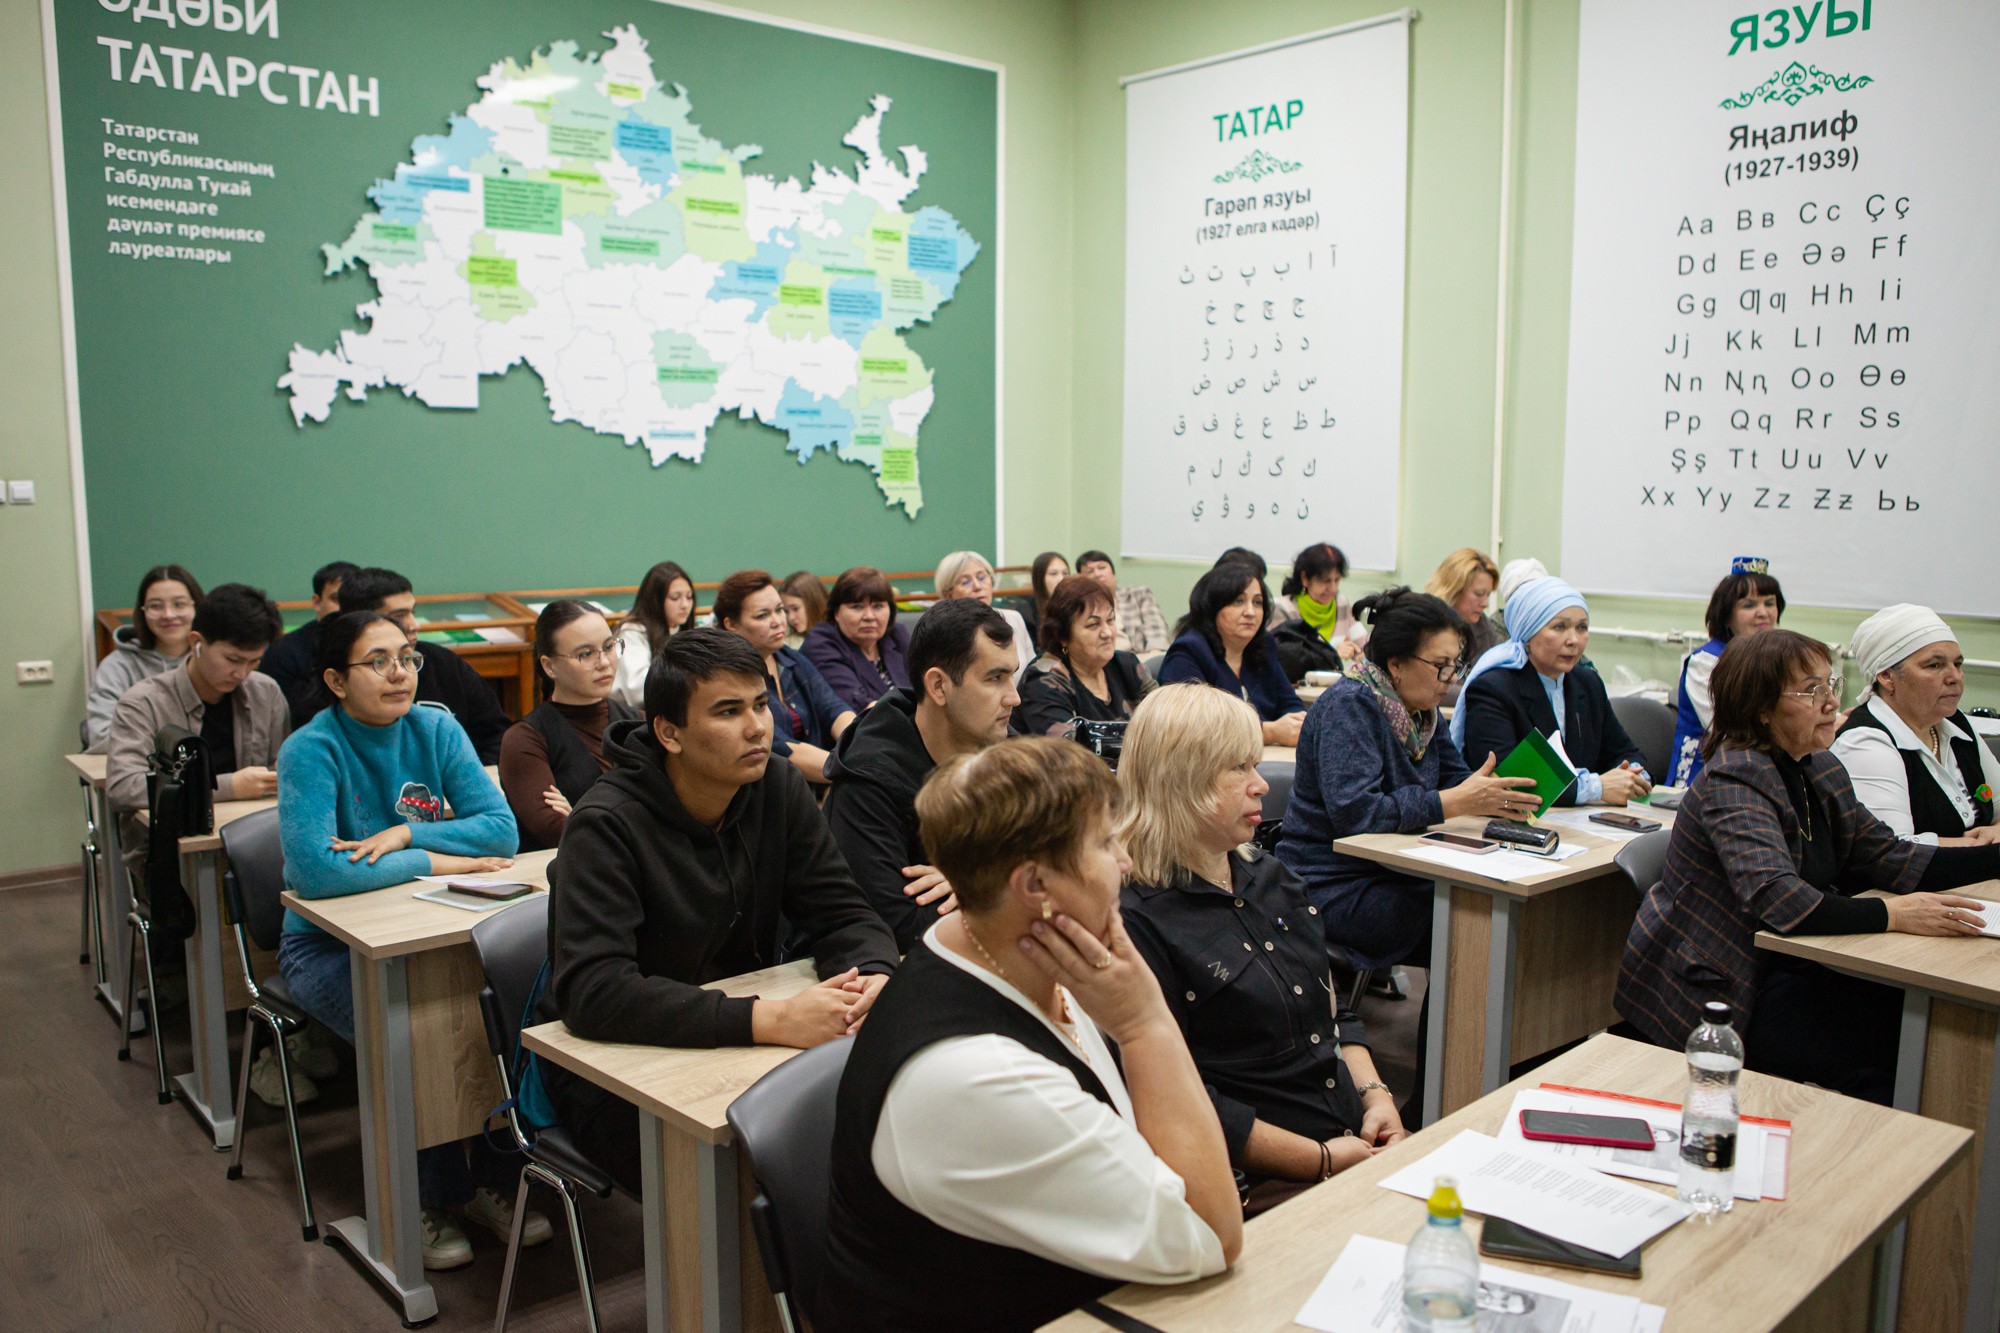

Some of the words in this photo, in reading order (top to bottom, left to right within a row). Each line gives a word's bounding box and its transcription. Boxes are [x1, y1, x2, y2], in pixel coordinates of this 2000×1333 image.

[1728, 0, 1872, 56] ЯЗУЫ
[97, 36, 380, 117] ТАТАРСТАН
[101, 118, 199, 146] Татарстан
[1213, 99, 1303, 142] ТАТАР
[1729, 109, 1858, 153] Яңалиф
[104, 141, 276, 178] Республикасының
[1725, 145, 1858, 186] (1927-1939)
[105, 166, 194, 190] Габдулла
[197, 176, 252, 196] Тукай
[107, 193, 218, 216] исемендәге
[1205, 197, 1256, 218] Гарәп
[1264, 189, 1310, 211] язуы
[107, 218, 174, 235] дәүләт
[178, 224, 266, 243] премиясе
[1197, 223, 1232, 244] (1927
[1236, 222, 1267, 236] елга
[1272, 212, 1319, 232] кадәр)
[109, 242, 232, 264] лауреатлары
